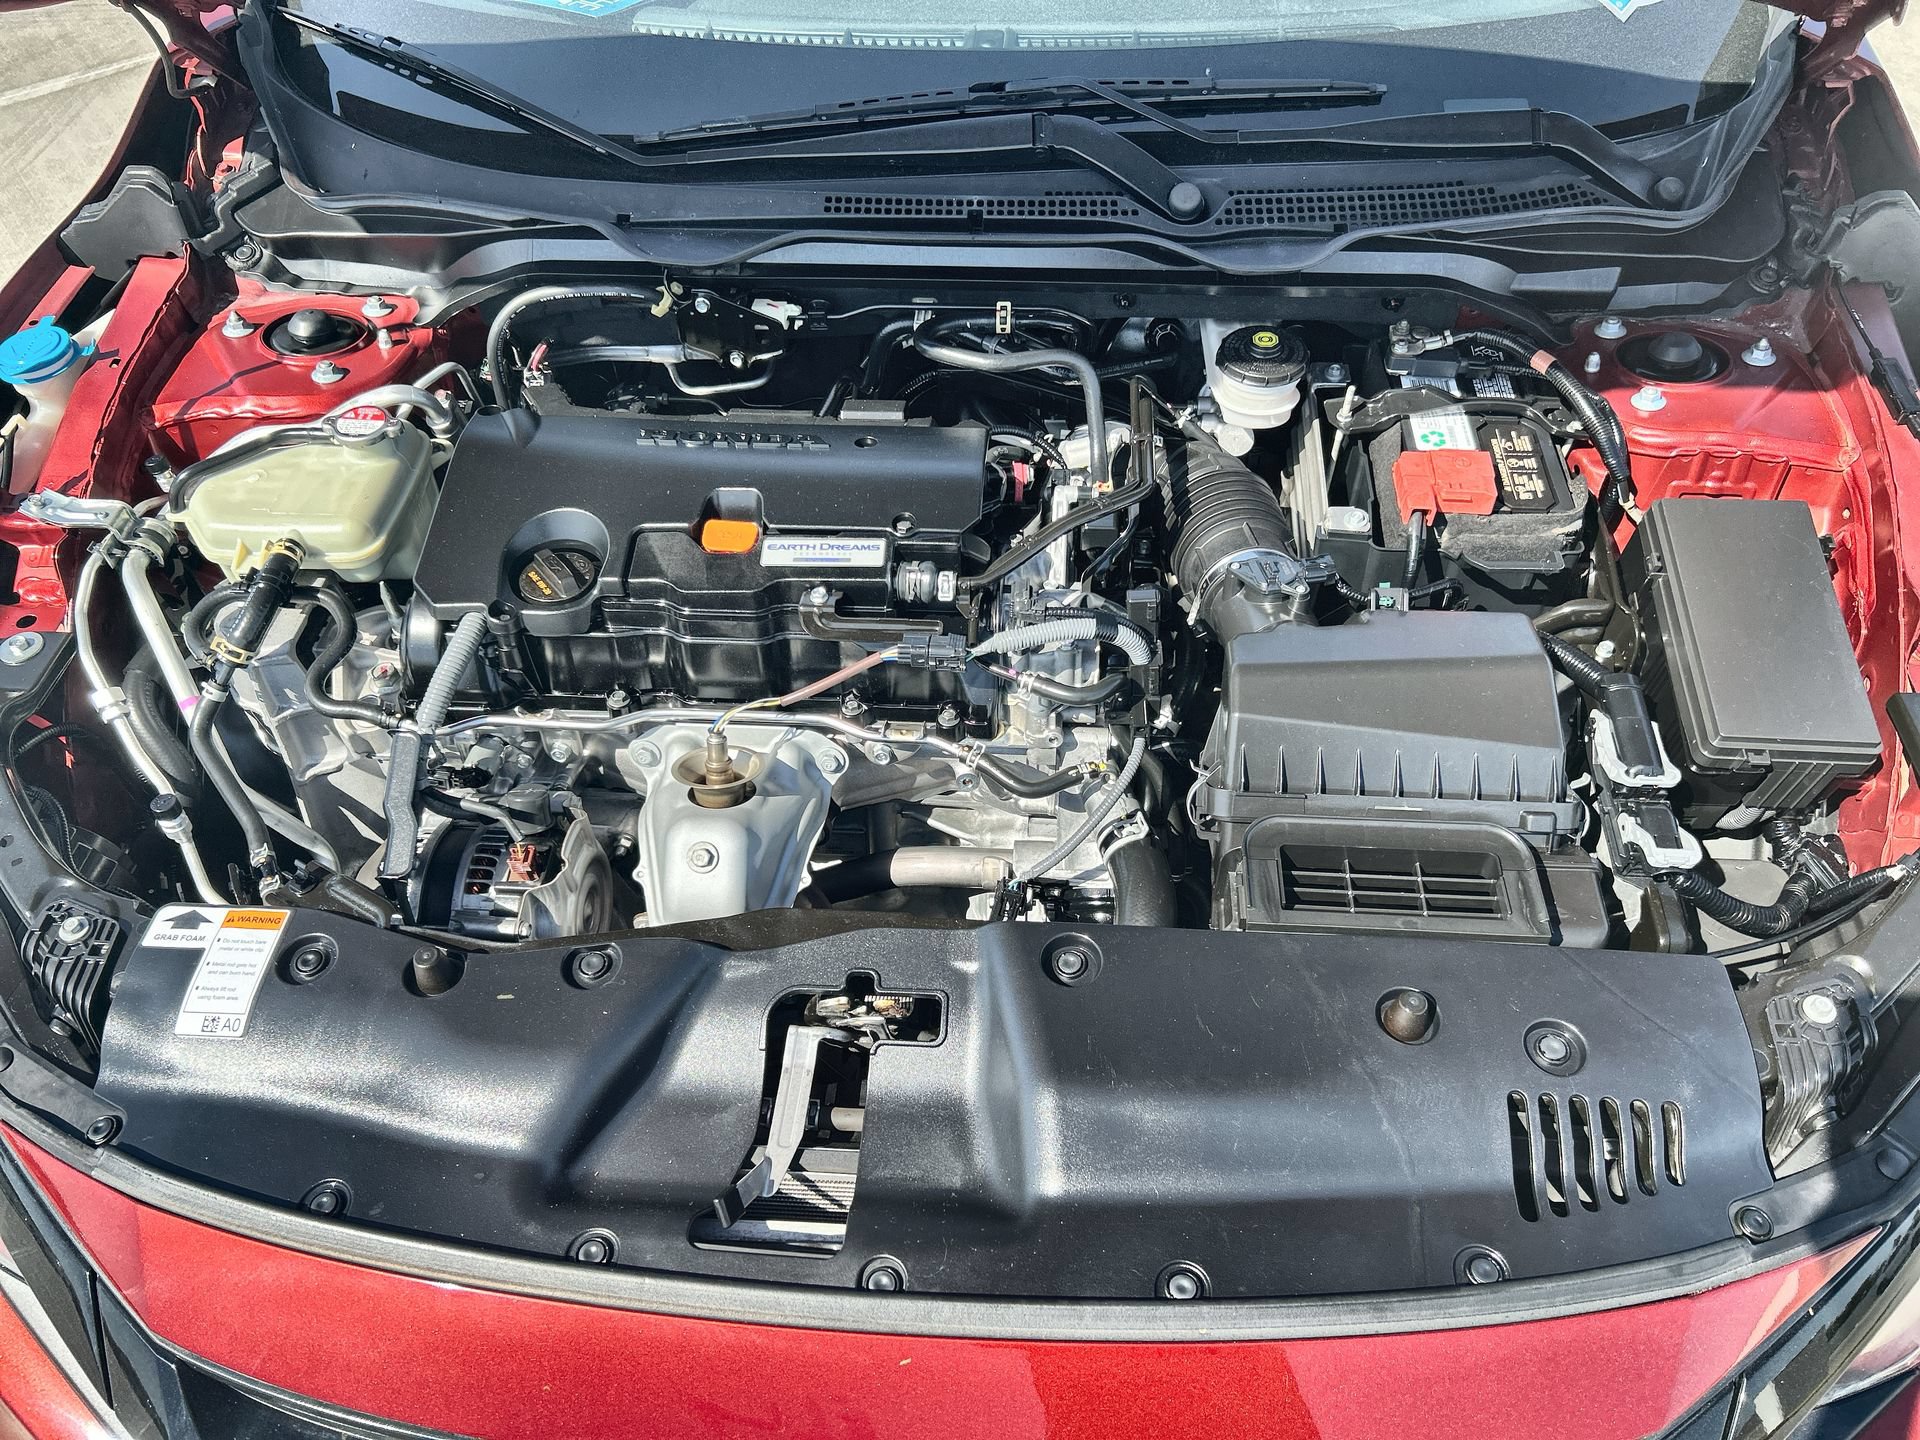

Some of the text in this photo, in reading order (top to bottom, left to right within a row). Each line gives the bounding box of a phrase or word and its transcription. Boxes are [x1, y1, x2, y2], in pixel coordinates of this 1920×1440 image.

[636, 428, 831, 450] HONDA
[766, 542, 881, 551] EARTH DREAMS
[236, 915, 282, 925] WARNING
[153, 933, 206, 942] GRAB FOAM
[220, 1017, 241, 1033] A0
